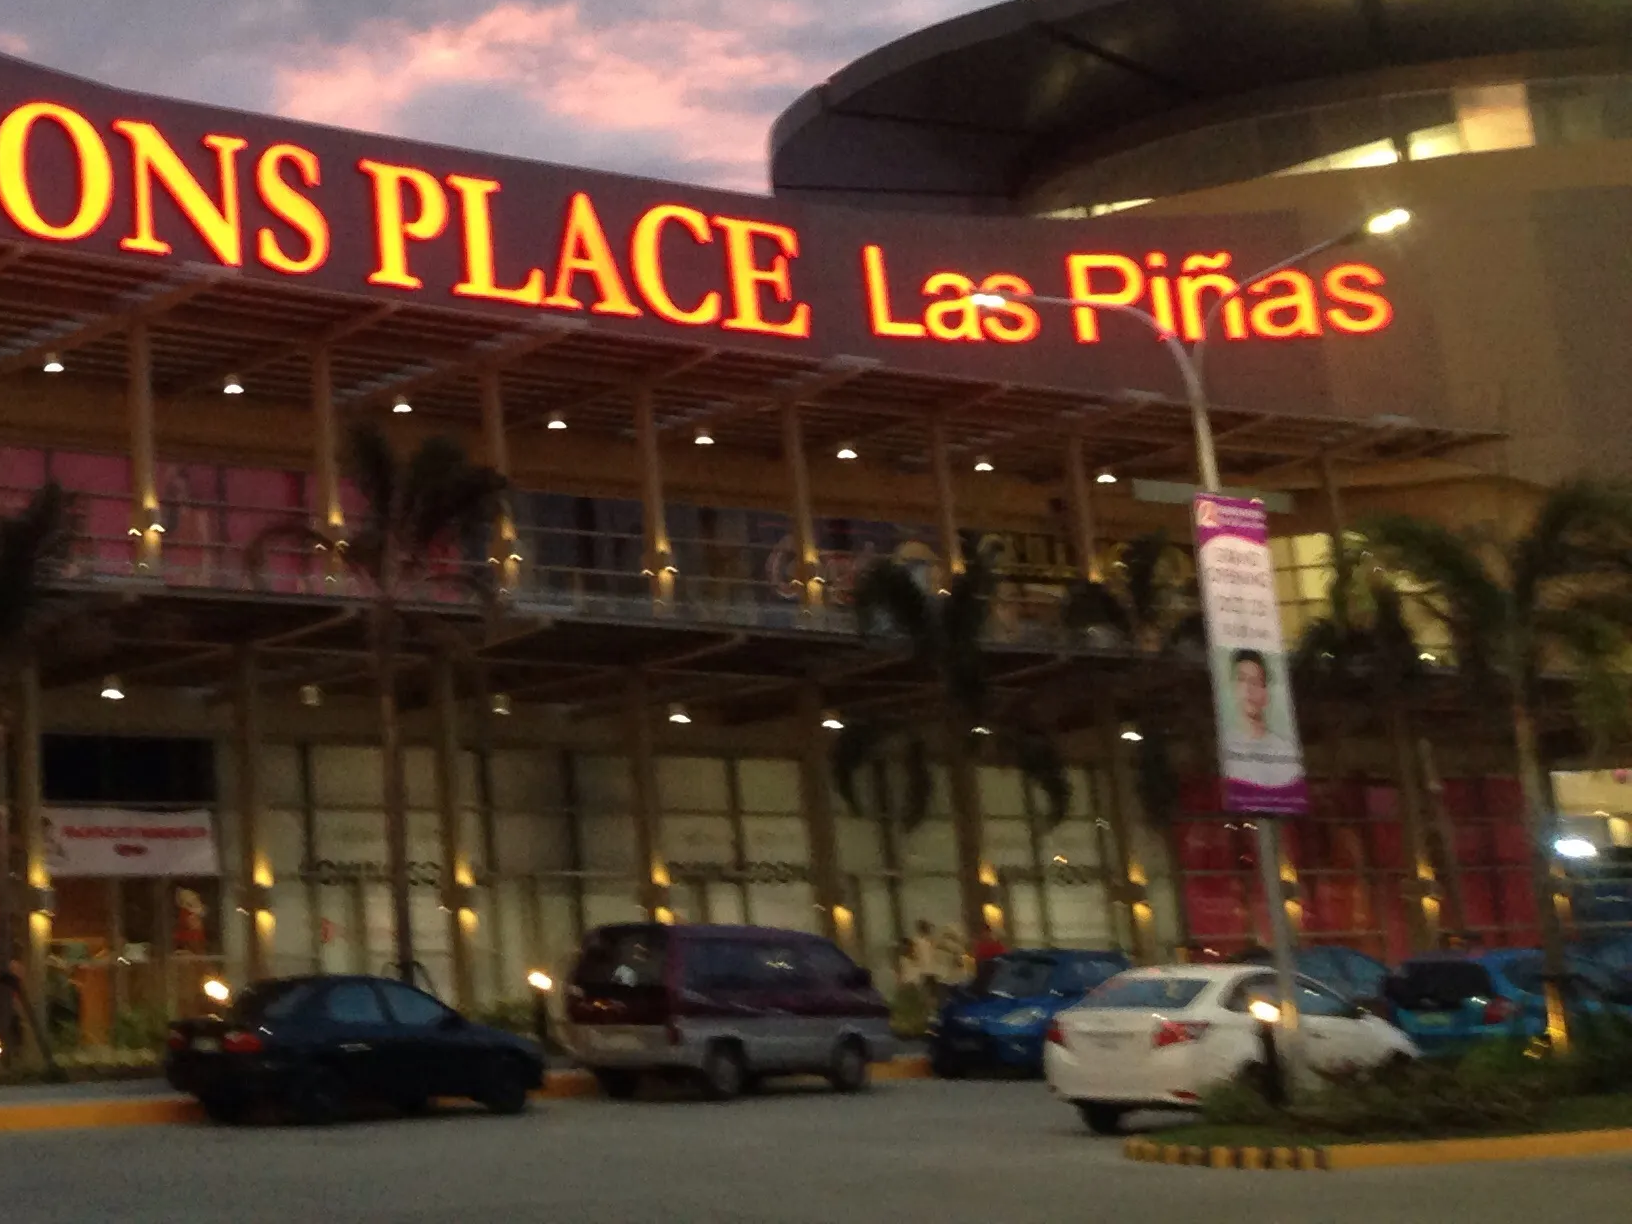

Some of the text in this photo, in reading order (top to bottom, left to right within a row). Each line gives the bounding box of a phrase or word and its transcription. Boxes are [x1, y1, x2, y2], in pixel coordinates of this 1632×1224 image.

[357, 158, 811, 339] PLACE
[862, 244, 1042, 344] Las
[1064, 250, 1394, 344] Piñas
